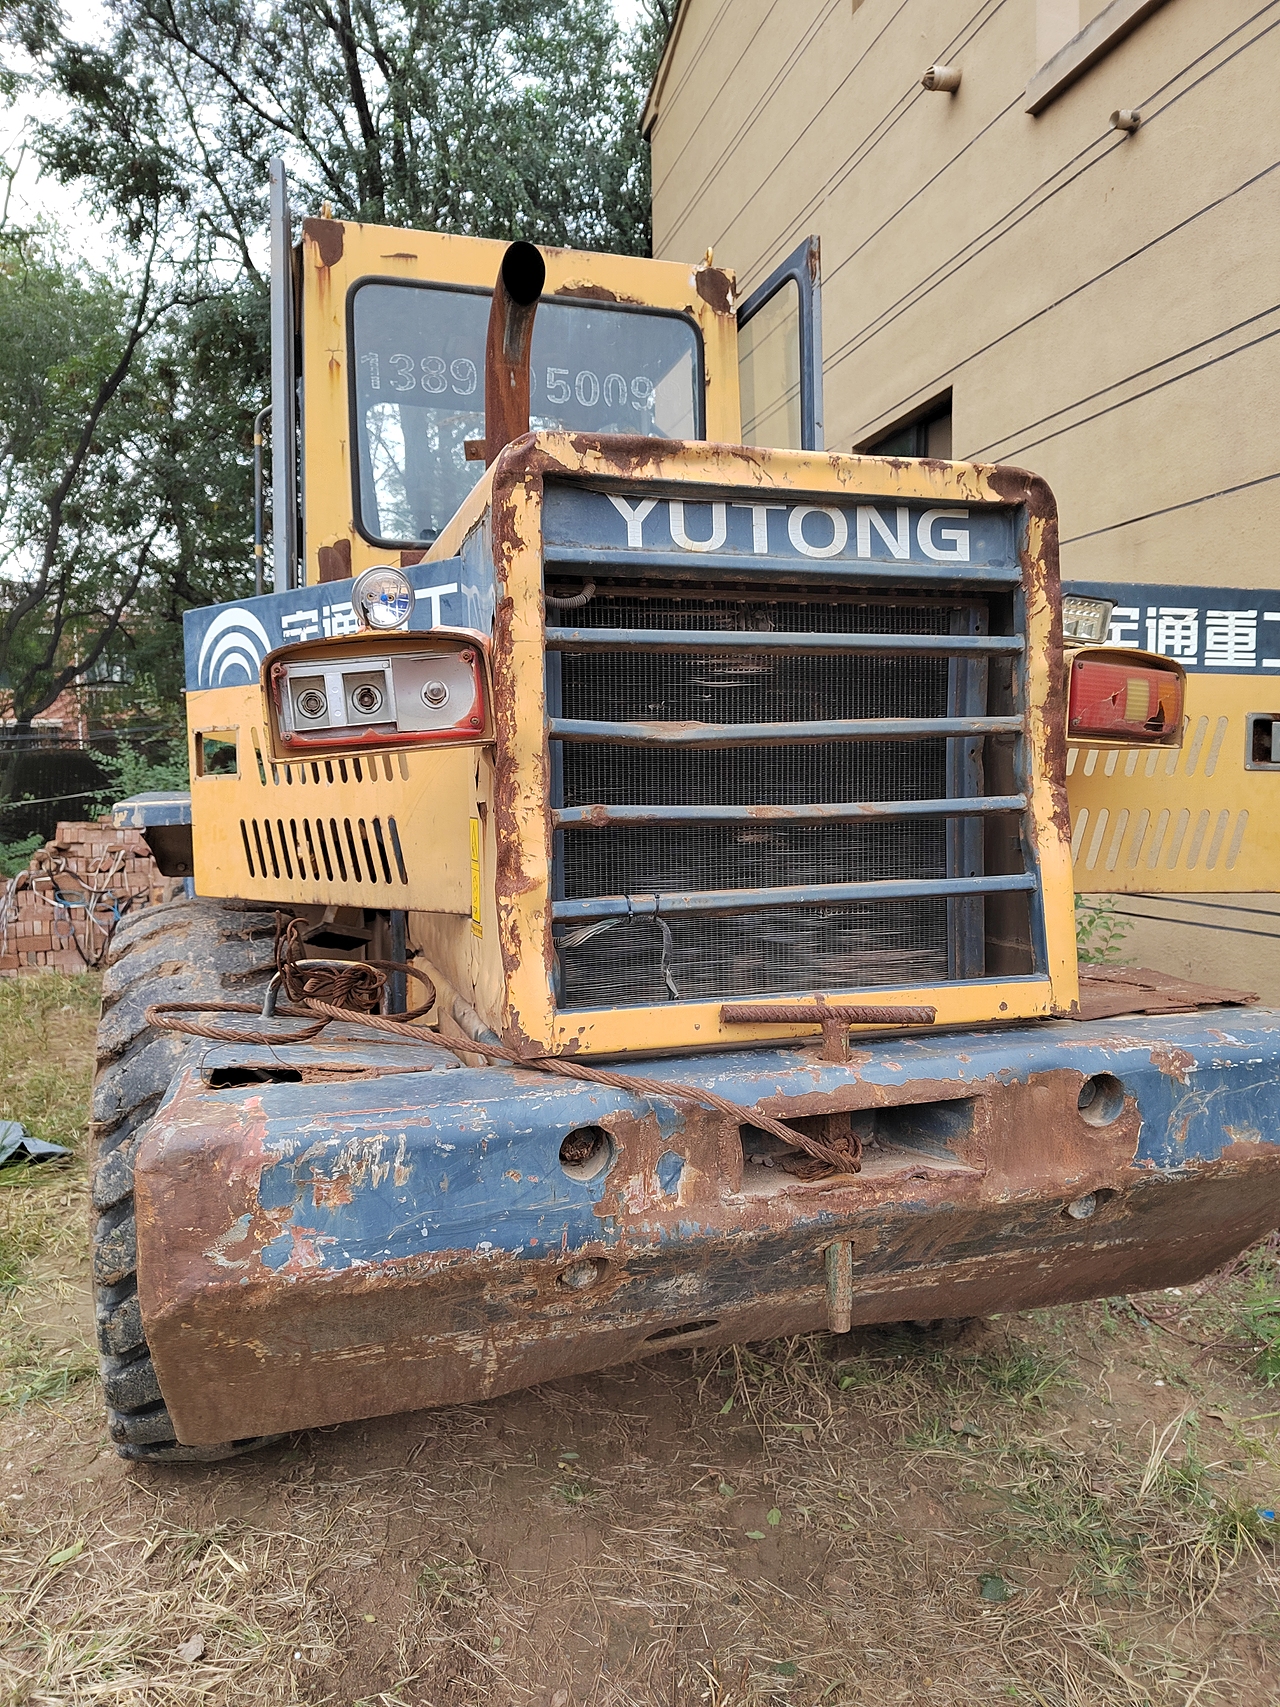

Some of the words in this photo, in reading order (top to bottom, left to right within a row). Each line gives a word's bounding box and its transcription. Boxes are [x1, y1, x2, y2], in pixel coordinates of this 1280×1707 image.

[604, 492, 971, 562] YUTONG
[281, 582, 458, 642] 宇通工
